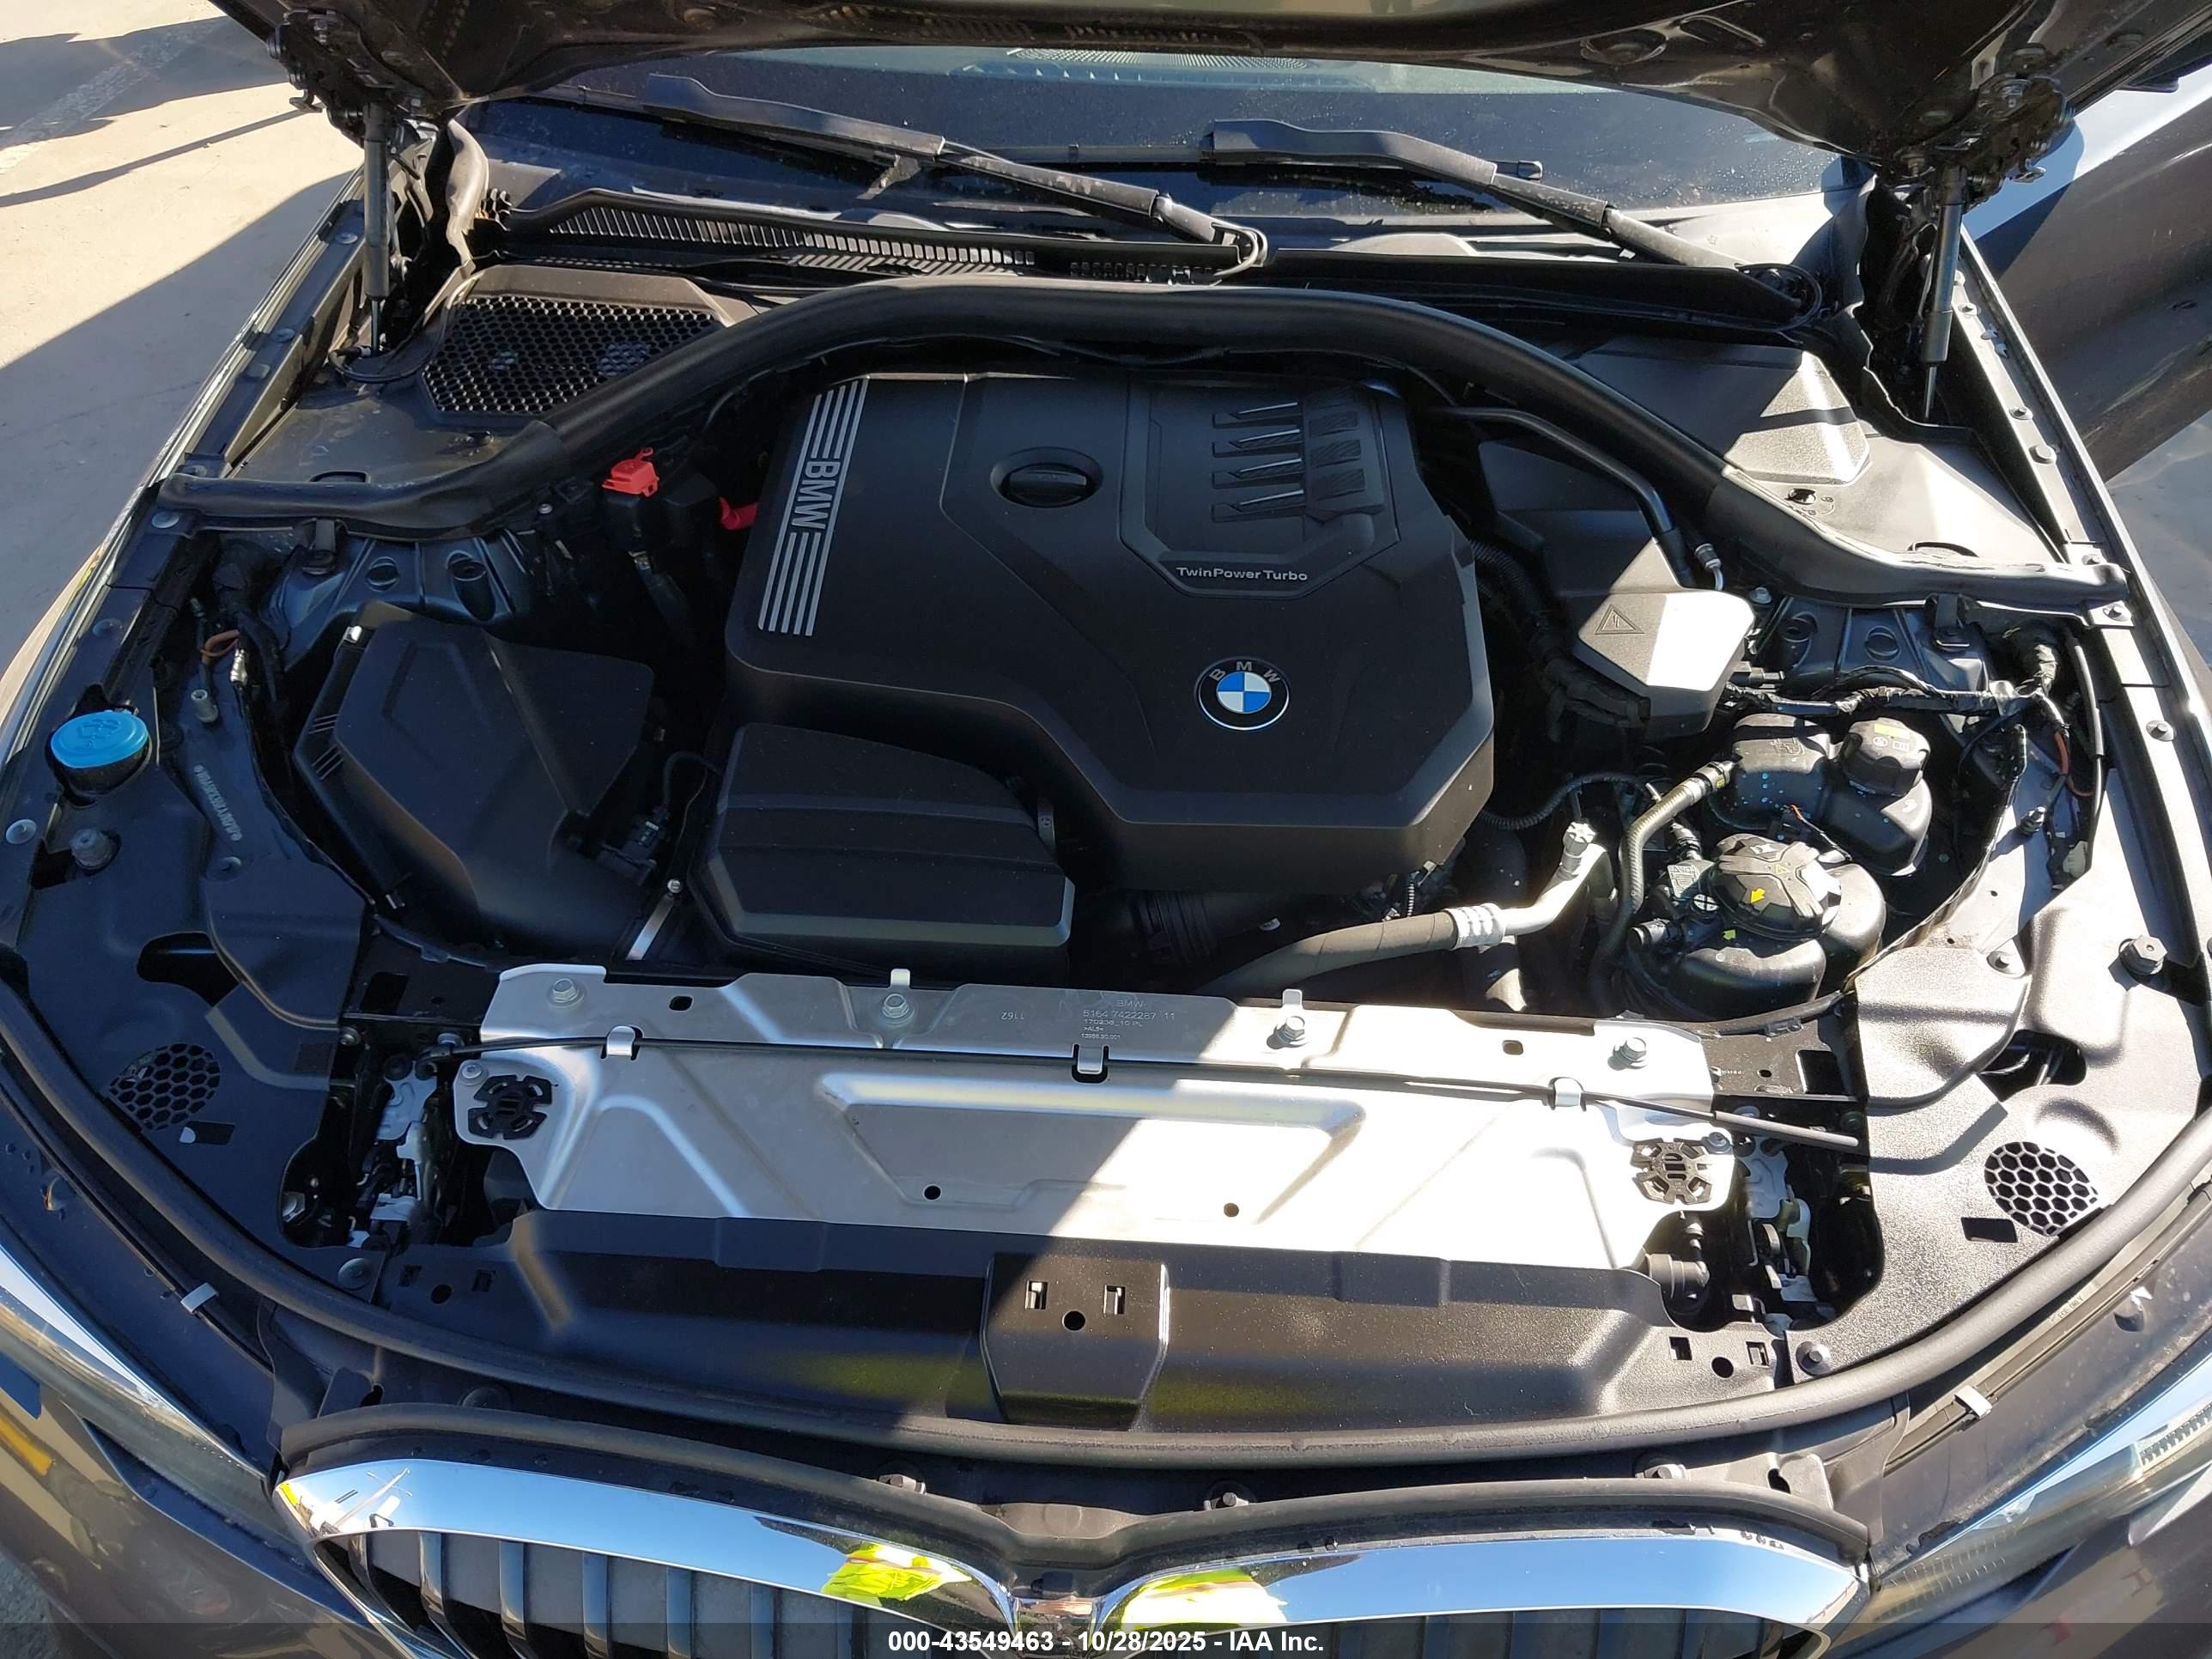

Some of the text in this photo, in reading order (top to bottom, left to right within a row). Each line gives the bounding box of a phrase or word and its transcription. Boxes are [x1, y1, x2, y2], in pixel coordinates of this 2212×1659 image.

[791, 460, 841, 531] BMW
[1176, 567, 1308, 581] TwinPower Turbo
[1209, 660, 1280, 683] BMW
